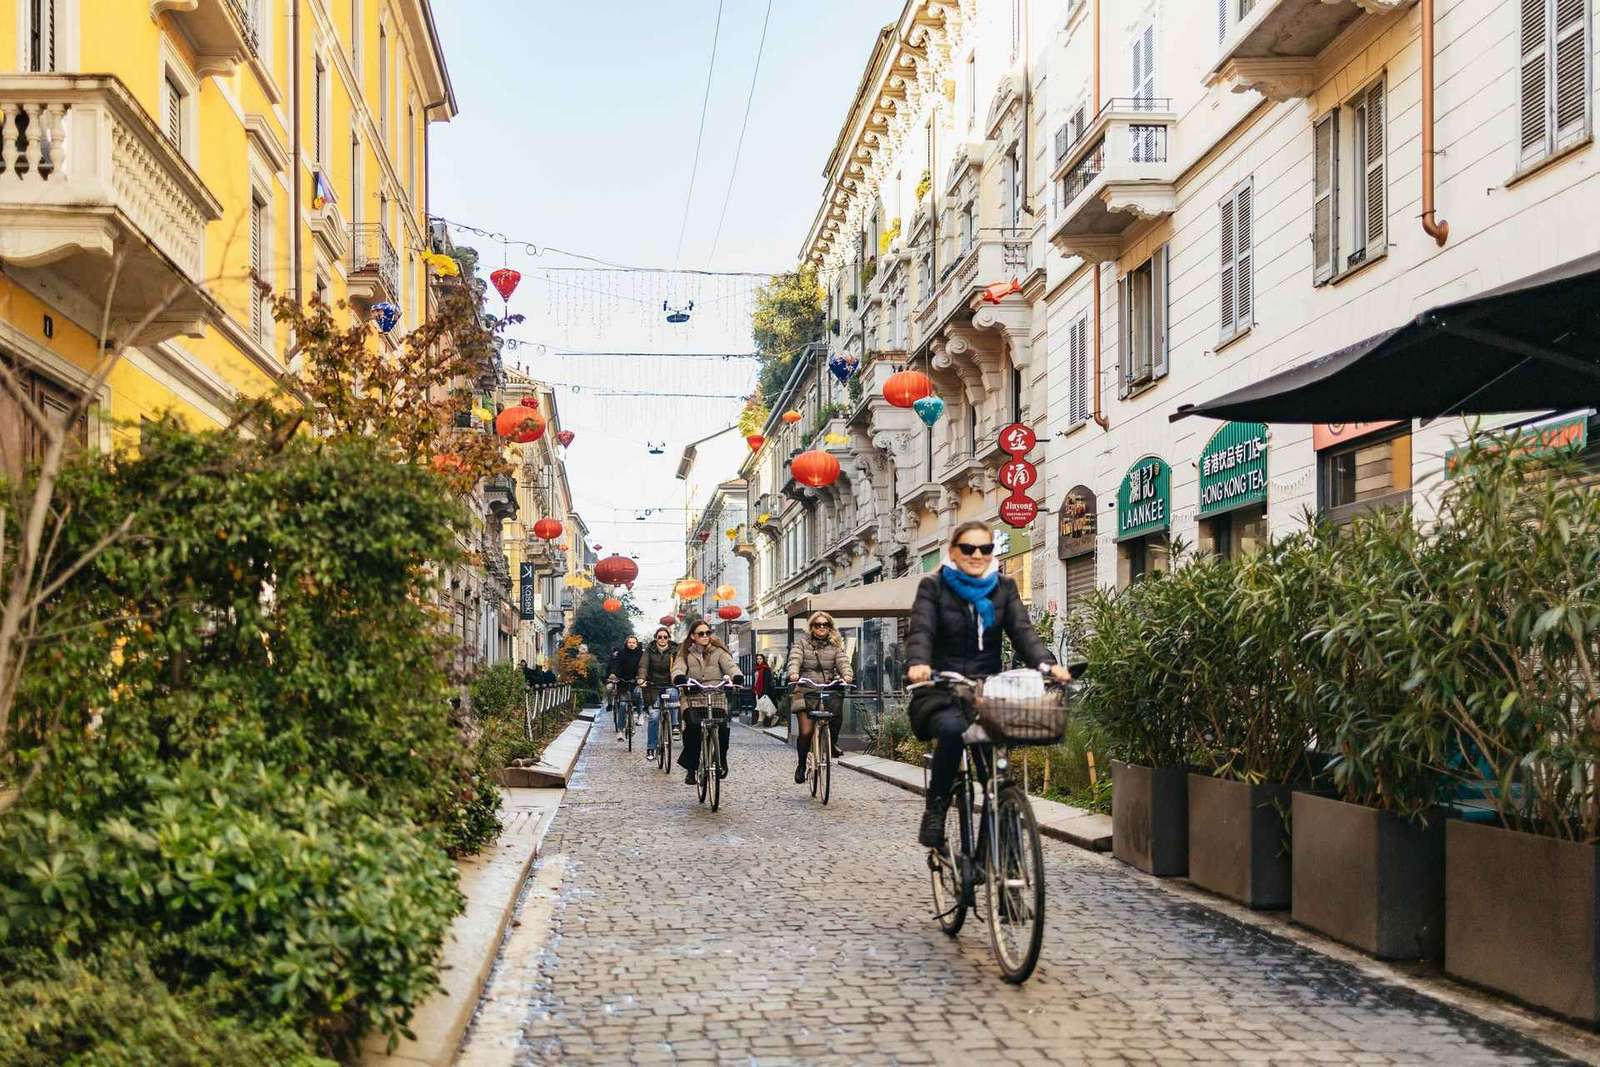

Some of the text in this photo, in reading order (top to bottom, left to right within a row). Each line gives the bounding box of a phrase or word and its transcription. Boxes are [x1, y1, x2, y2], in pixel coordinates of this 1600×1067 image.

[1201, 468, 1264, 505] HONG KONG TEA
[1005, 501, 1033, 511] Jinyong
[1122, 498, 1164, 530] LAANKEE
